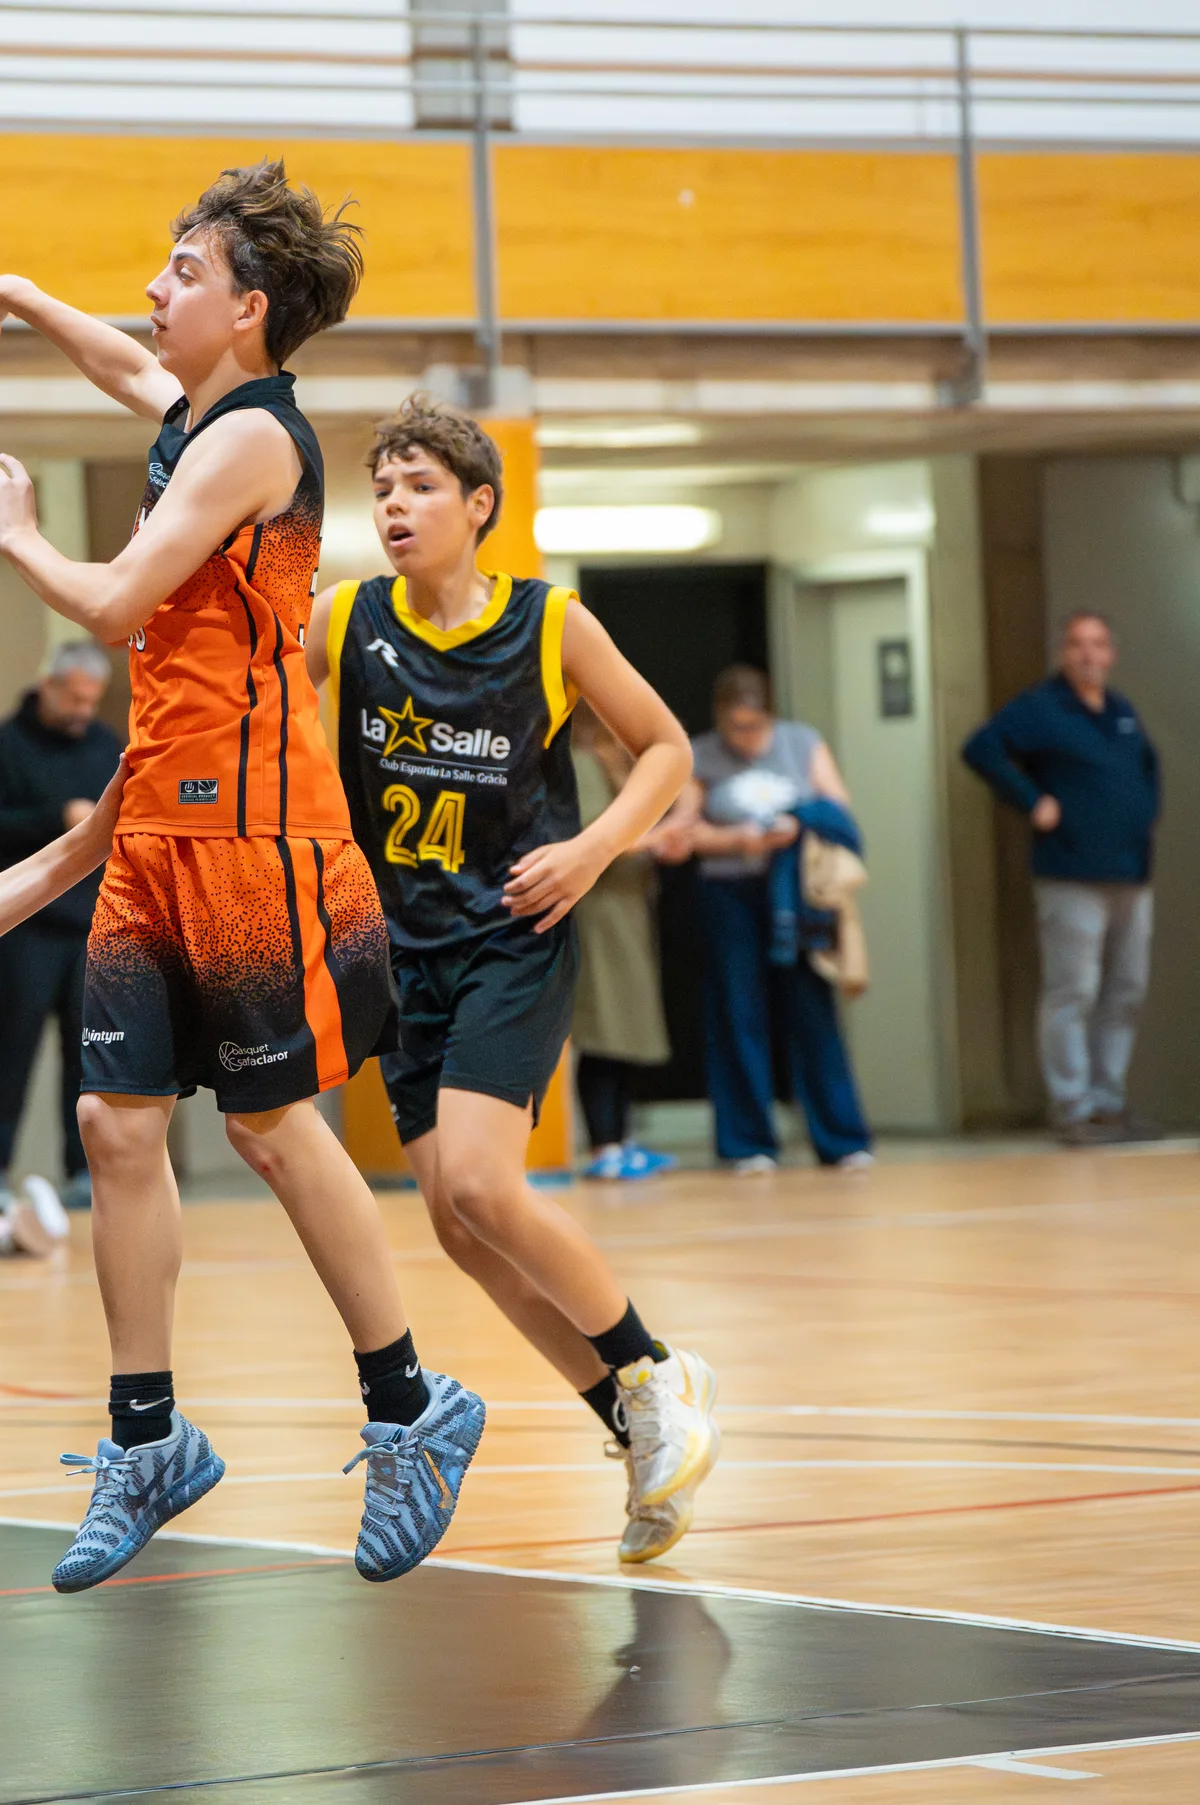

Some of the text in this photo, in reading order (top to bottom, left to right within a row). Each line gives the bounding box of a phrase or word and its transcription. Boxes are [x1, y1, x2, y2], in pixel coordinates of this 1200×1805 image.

[361, 708, 511, 760] La Salle
[380, 757, 399, 772] Club
[400, 761, 439, 776] Esportiu
[440, 767, 451, 779] La
[453, 769, 476, 782] Salle
[381, 784, 466, 873] 24
[237, 1051, 289, 1067] safaclaror
